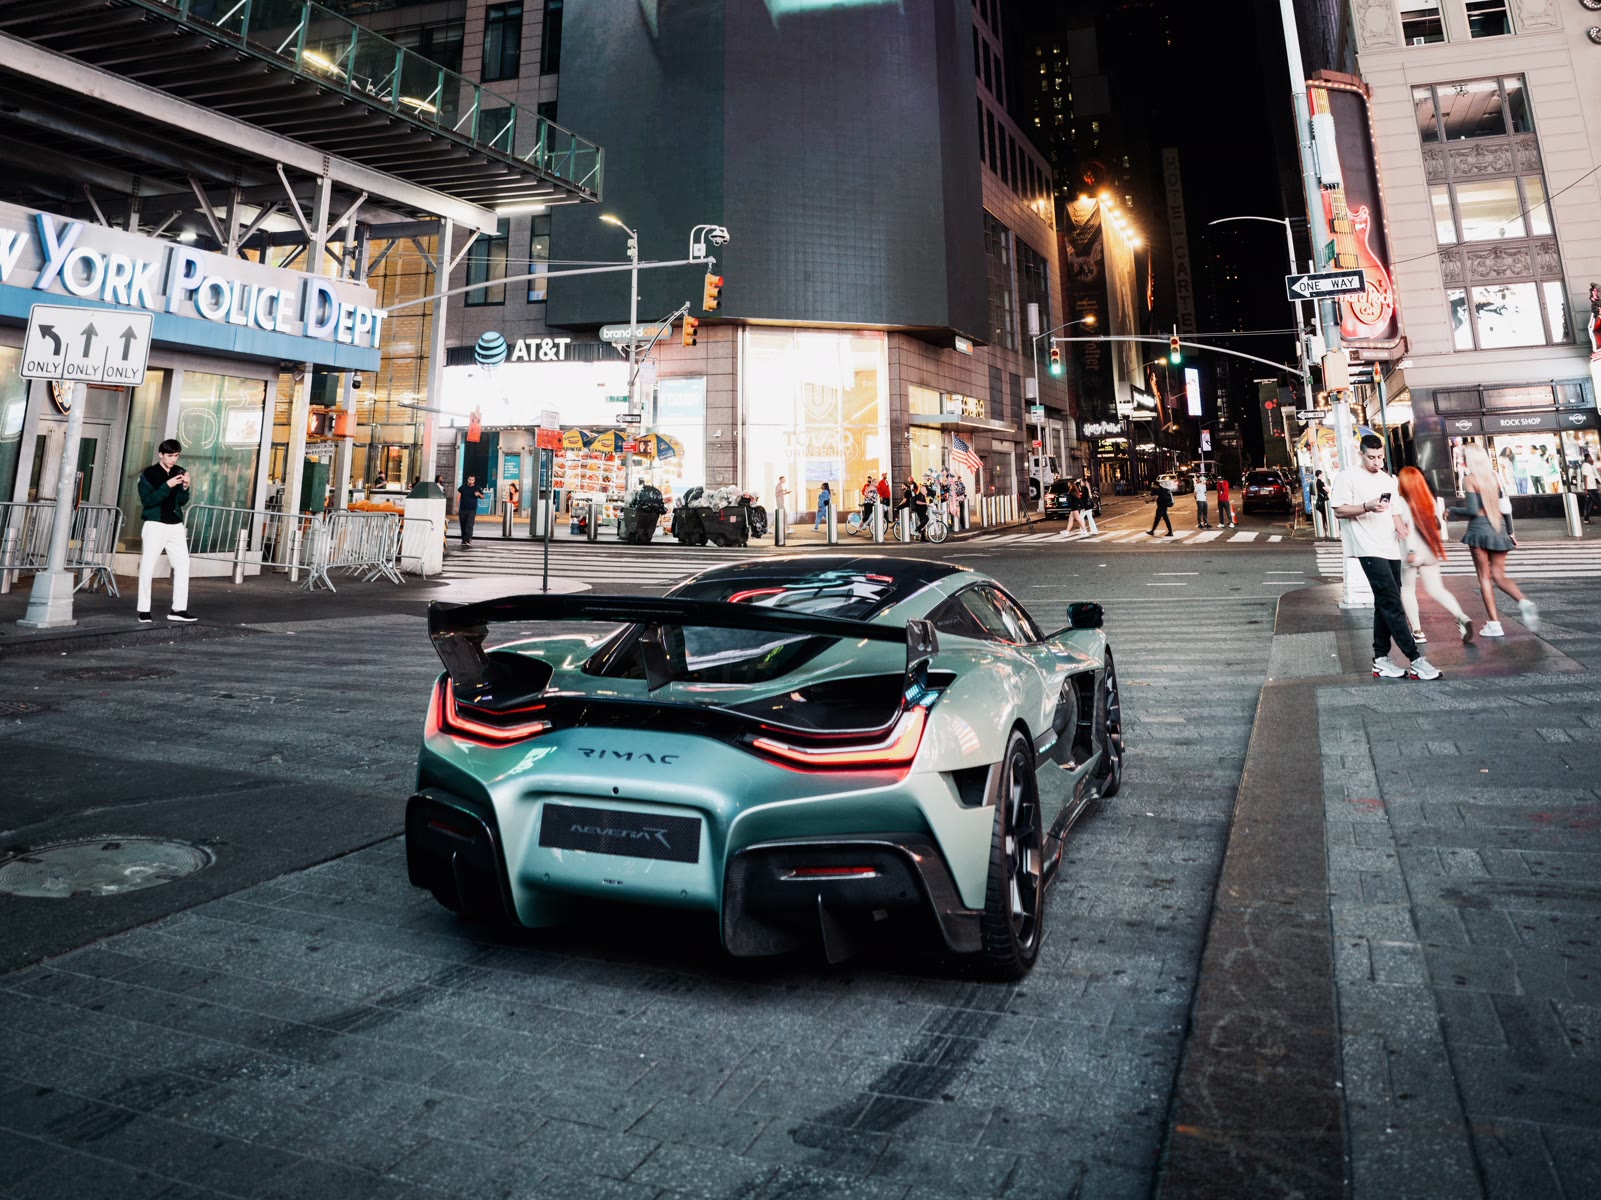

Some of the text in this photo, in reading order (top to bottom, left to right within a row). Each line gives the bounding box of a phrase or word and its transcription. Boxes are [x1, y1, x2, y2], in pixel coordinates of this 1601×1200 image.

[32, 213, 160, 308] YORK
[164, 245, 294, 332] POLICE
[303, 277, 388, 349] DEPT
[1299, 277, 1354, 292] ONE WAY
[511, 337, 571, 362] AT&T
[27, 360, 61, 373] ONLY
[66, 363, 100, 376] ONLY
[106, 366, 140, 379] ONLY
[1500, 417, 1541, 427] ROCK SHOP
[577, 747, 680, 765] RIMAC
